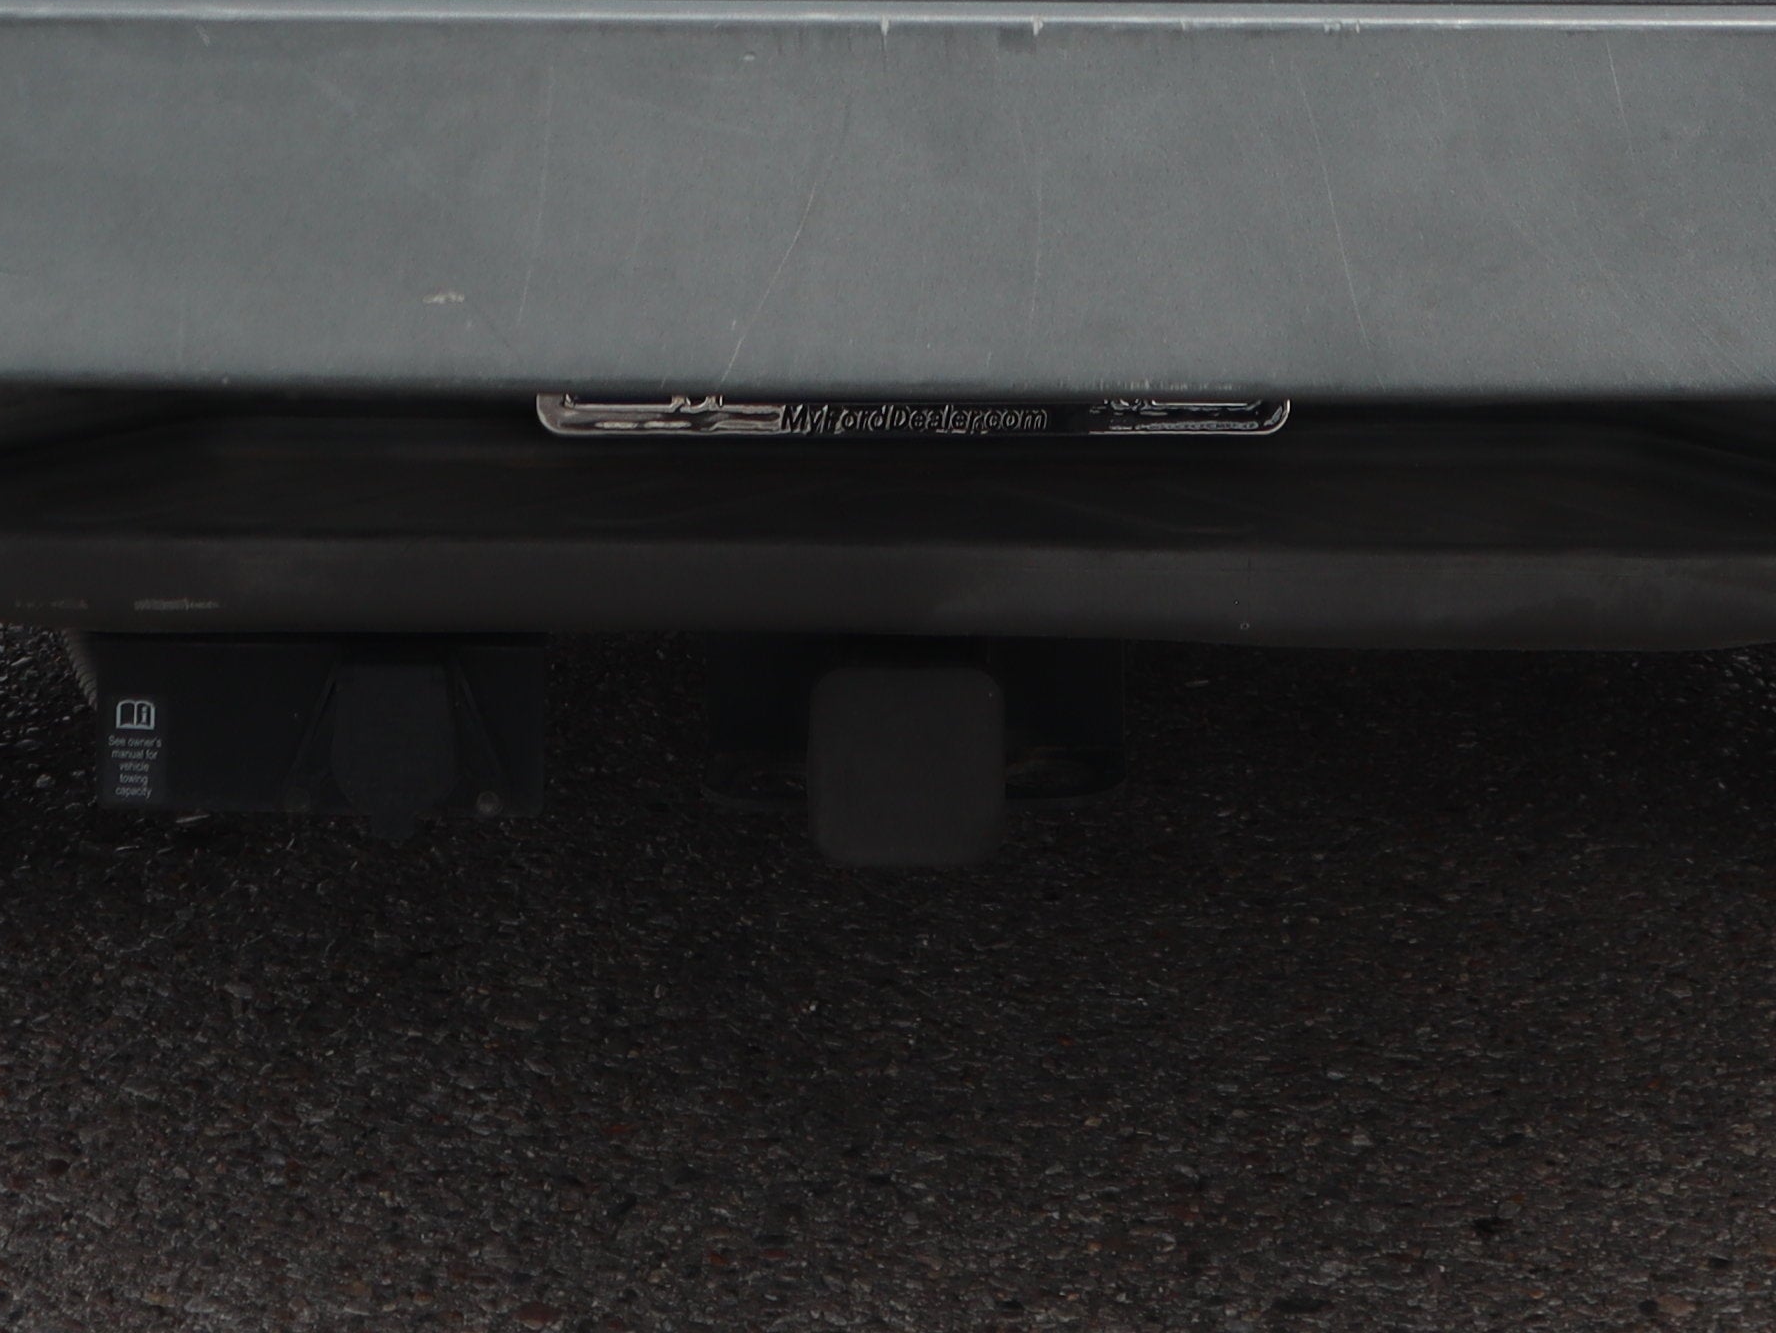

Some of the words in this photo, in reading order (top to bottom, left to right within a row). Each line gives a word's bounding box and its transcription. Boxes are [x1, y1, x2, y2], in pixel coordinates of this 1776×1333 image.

[108, 735, 126, 746] See
[127, 737, 162, 748] owner's
[111, 749, 144, 759] manual
[145, 749, 158, 760] for
[119, 762, 149, 772] vehicle
[120, 773, 148, 786] towing
[115, 787, 152, 800] capacity
